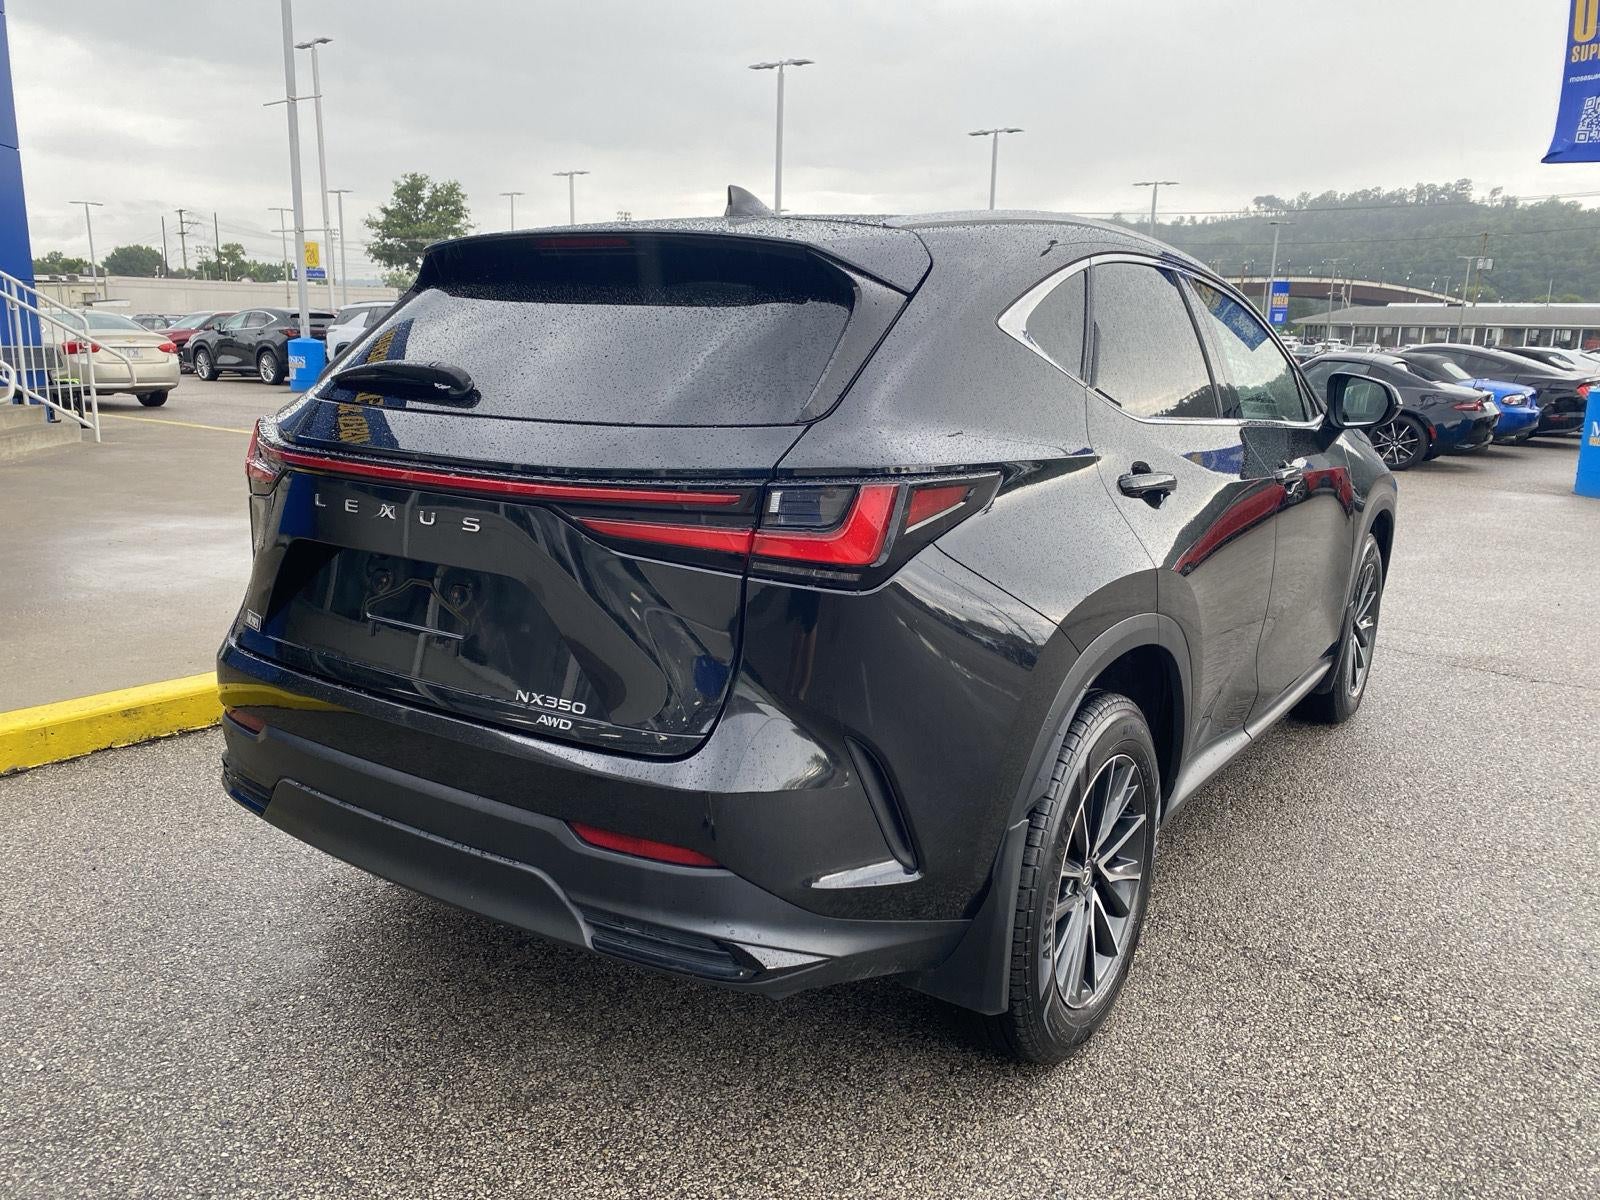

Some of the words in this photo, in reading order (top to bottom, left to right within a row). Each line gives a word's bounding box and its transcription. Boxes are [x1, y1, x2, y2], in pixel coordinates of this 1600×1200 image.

[314, 493, 481, 533] LEXUS
[515, 689, 587, 715] NX350
[536, 714, 572, 730] AWD
